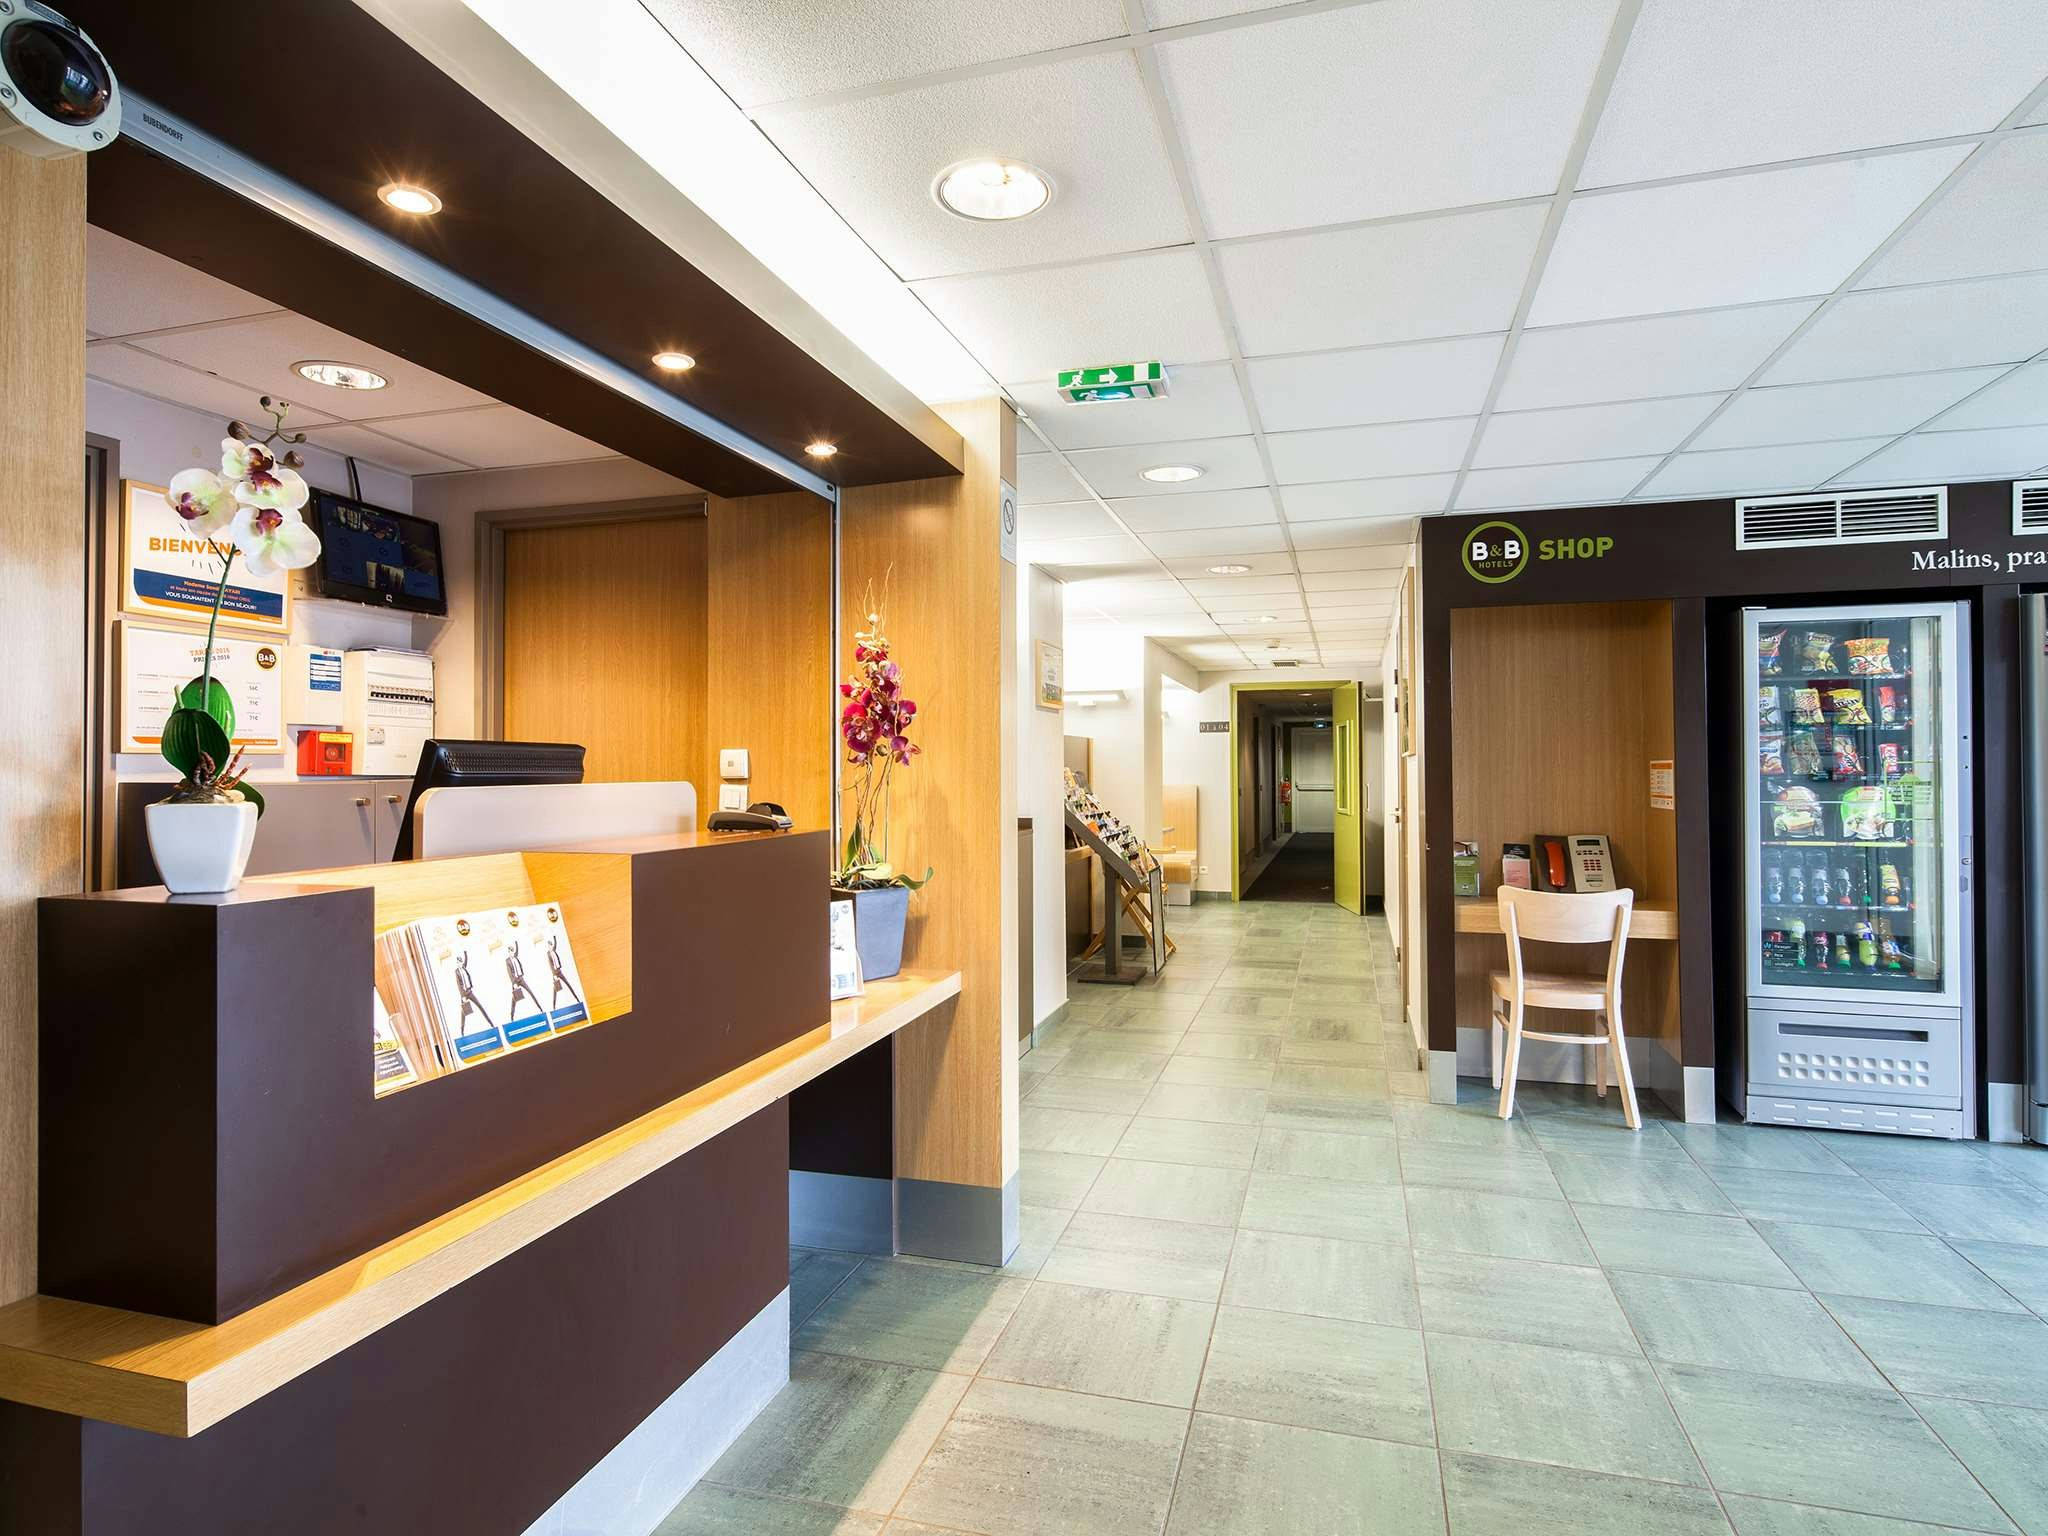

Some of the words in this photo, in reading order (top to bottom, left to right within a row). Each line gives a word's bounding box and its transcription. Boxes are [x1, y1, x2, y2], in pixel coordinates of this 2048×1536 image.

[142, 113, 184, 142] BUBENDORFF
[148, 536, 247, 557] BIENVEN
[1472, 540, 1521, 561] B&B
[1538, 536, 1615, 560] SHOP
[1478, 560, 1514, 569] HOTELS
[1911, 549, 2000, 572] Malins,
[2006, 550, 2048, 573] pra
[165, 591, 181, 599] VOUS
[181, 593, 215, 604] SOUHAITENT
[258, 653, 276, 663] B&B
